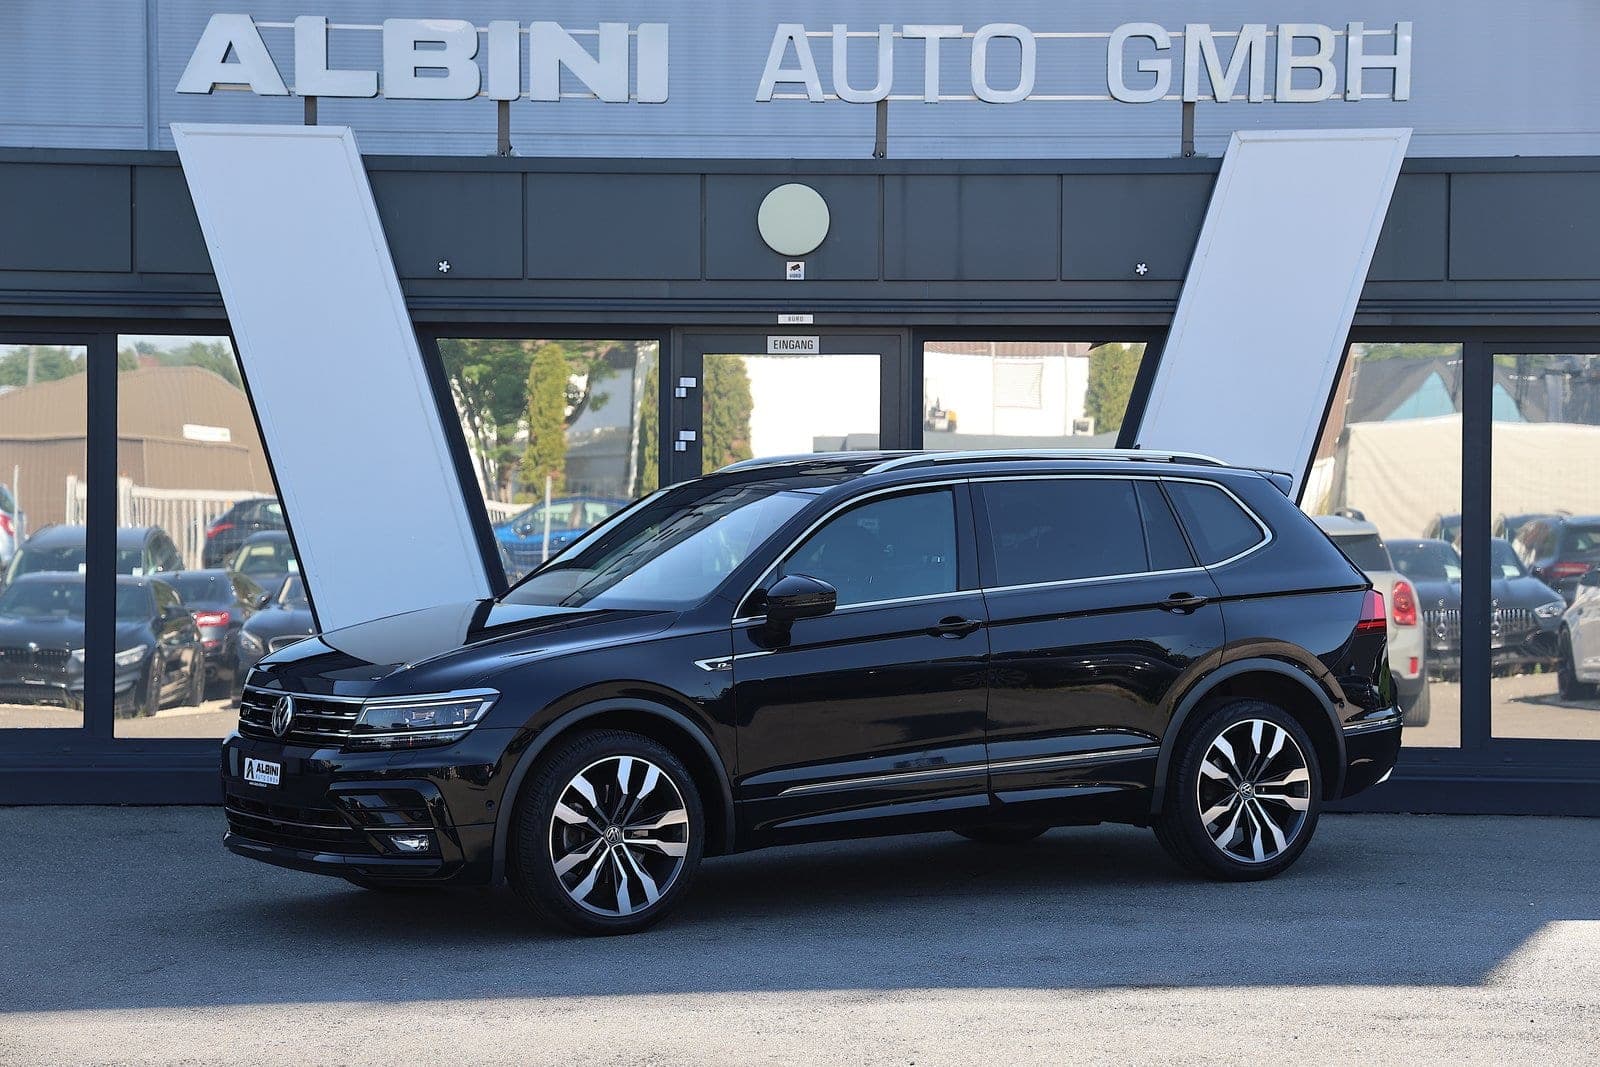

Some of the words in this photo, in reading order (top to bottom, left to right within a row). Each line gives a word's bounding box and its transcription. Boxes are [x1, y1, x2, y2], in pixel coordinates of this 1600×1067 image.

[175, 13, 669, 103] ALBINI
[755, 22, 1037, 104] AUTO
[1106, 21, 1413, 104] GMBH
[773, 339, 814, 350] EINGANG
[256, 762, 279, 776] ALBINI
